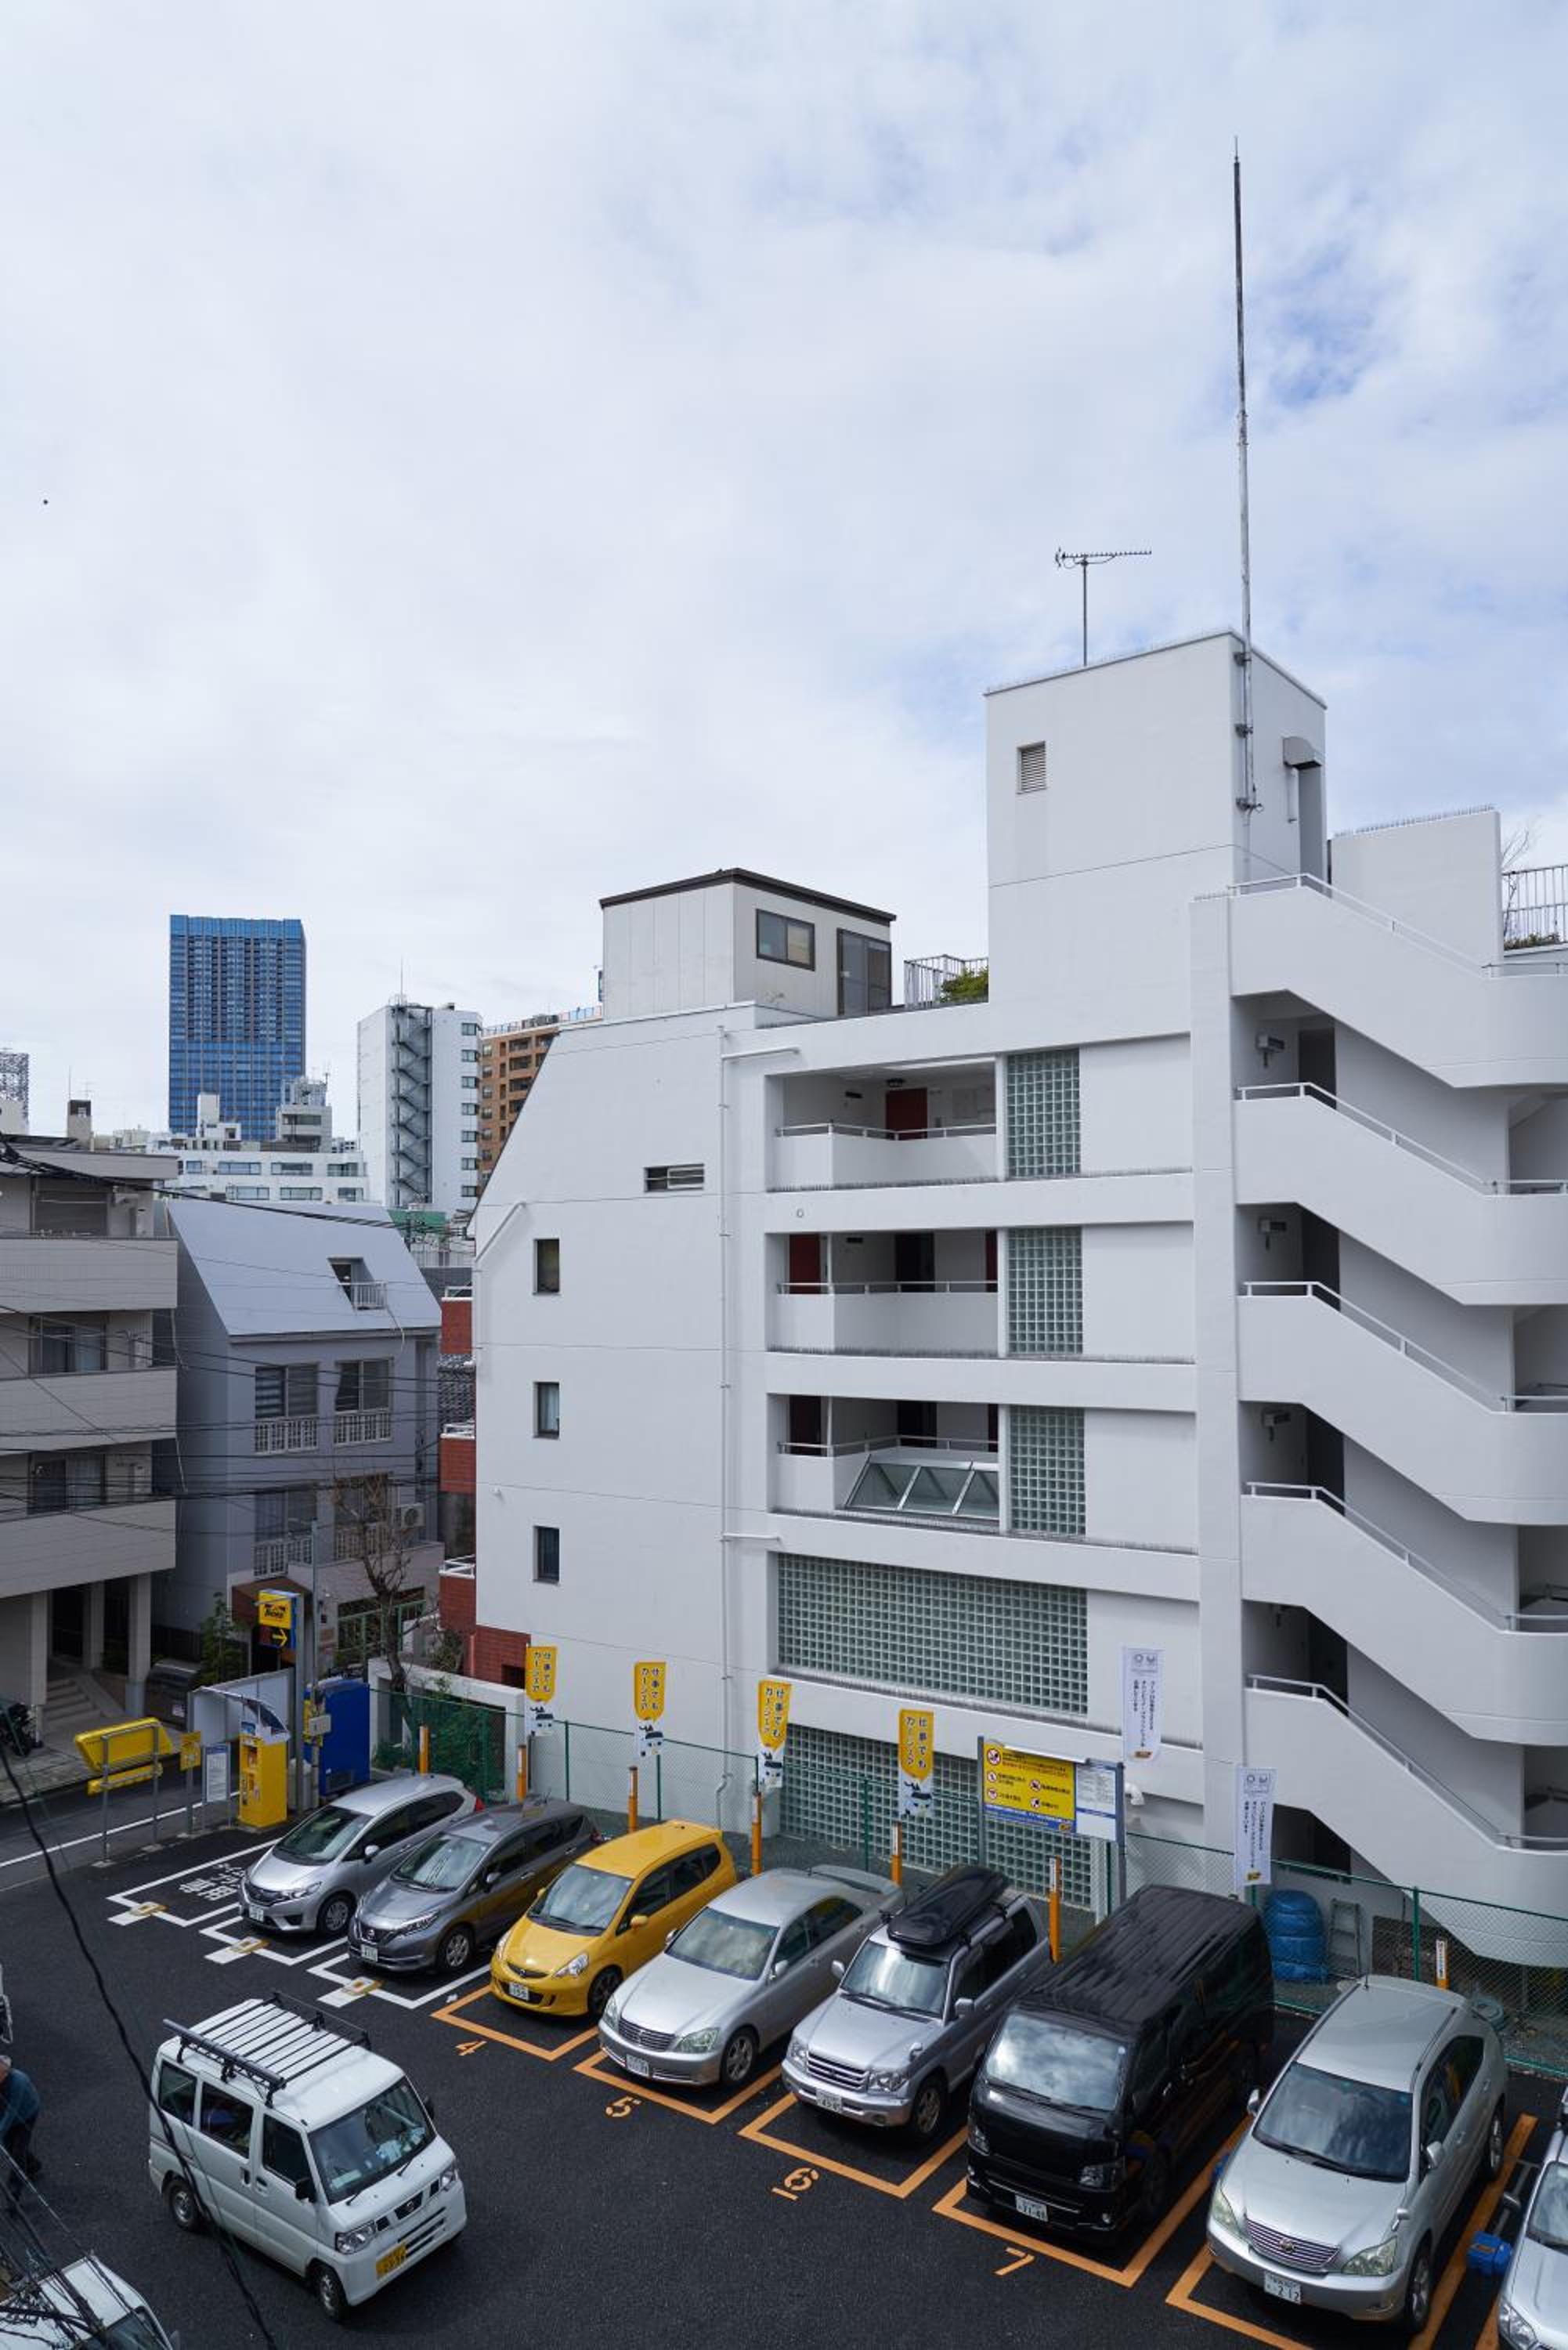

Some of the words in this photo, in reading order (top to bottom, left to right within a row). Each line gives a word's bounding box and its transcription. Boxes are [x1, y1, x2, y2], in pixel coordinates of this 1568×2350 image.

[455, 2041, 487, 2056] 4
[605, 2097, 642, 2117] 5
[995, 2247, 1034, 2276] 7
